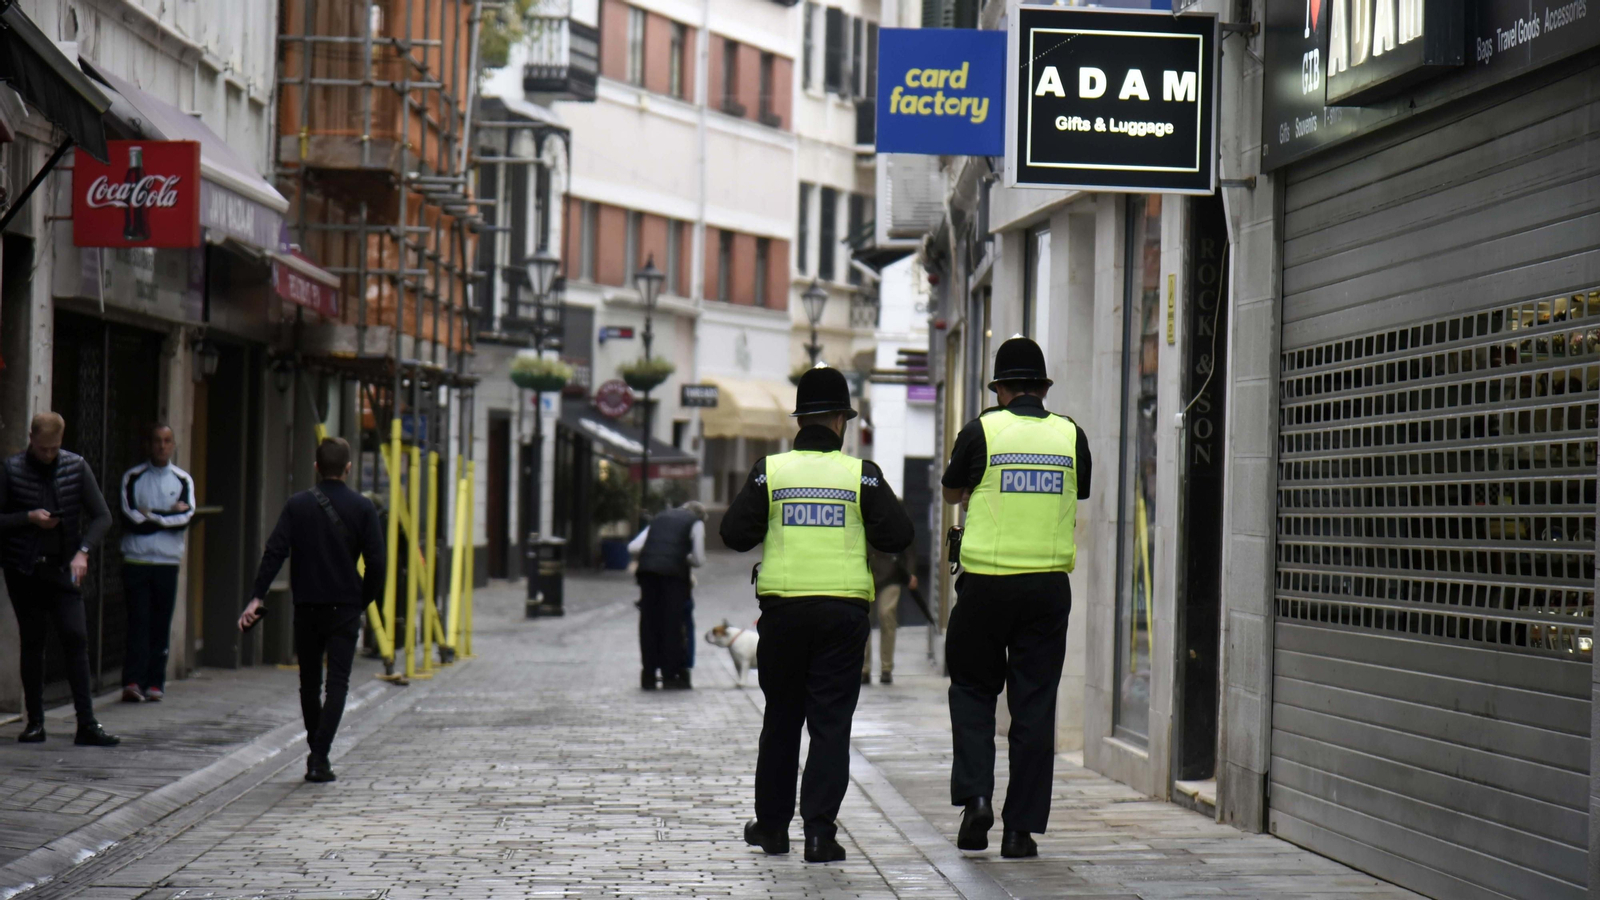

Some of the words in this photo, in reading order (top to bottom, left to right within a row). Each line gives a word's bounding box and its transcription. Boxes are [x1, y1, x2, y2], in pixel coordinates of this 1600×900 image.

[1476, 37, 1493, 65] Bags
[1497, 21, 1517, 53] Travel
[1518, 12, 1540, 44] Goods
[1544, 0, 1587, 33] Accessories
[905, 61, 970, 89] card
[1035, 66, 1196, 102] ADAM
[1302, 48, 1320, 95] GIB
[889, 85, 990, 124] factory
[1055, 116, 1091, 132] Gifts
[1094, 117, 1107, 132] &
[1109, 118, 1174, 137] Luggage
[1279, 121, 1290, 145] Gifts
[1295, 112, 1317, 139] Souvenirs
[87, 174, 181, 209] Coca-Cola
[1198, 238, 1216, 338] ROCK
[1195, 353, 1212, 376] &
[1193, 391, 1213, 465] SON
[1002, 470, 1062, 493] POLICE
[784, 504, 844, 526] POLICE
